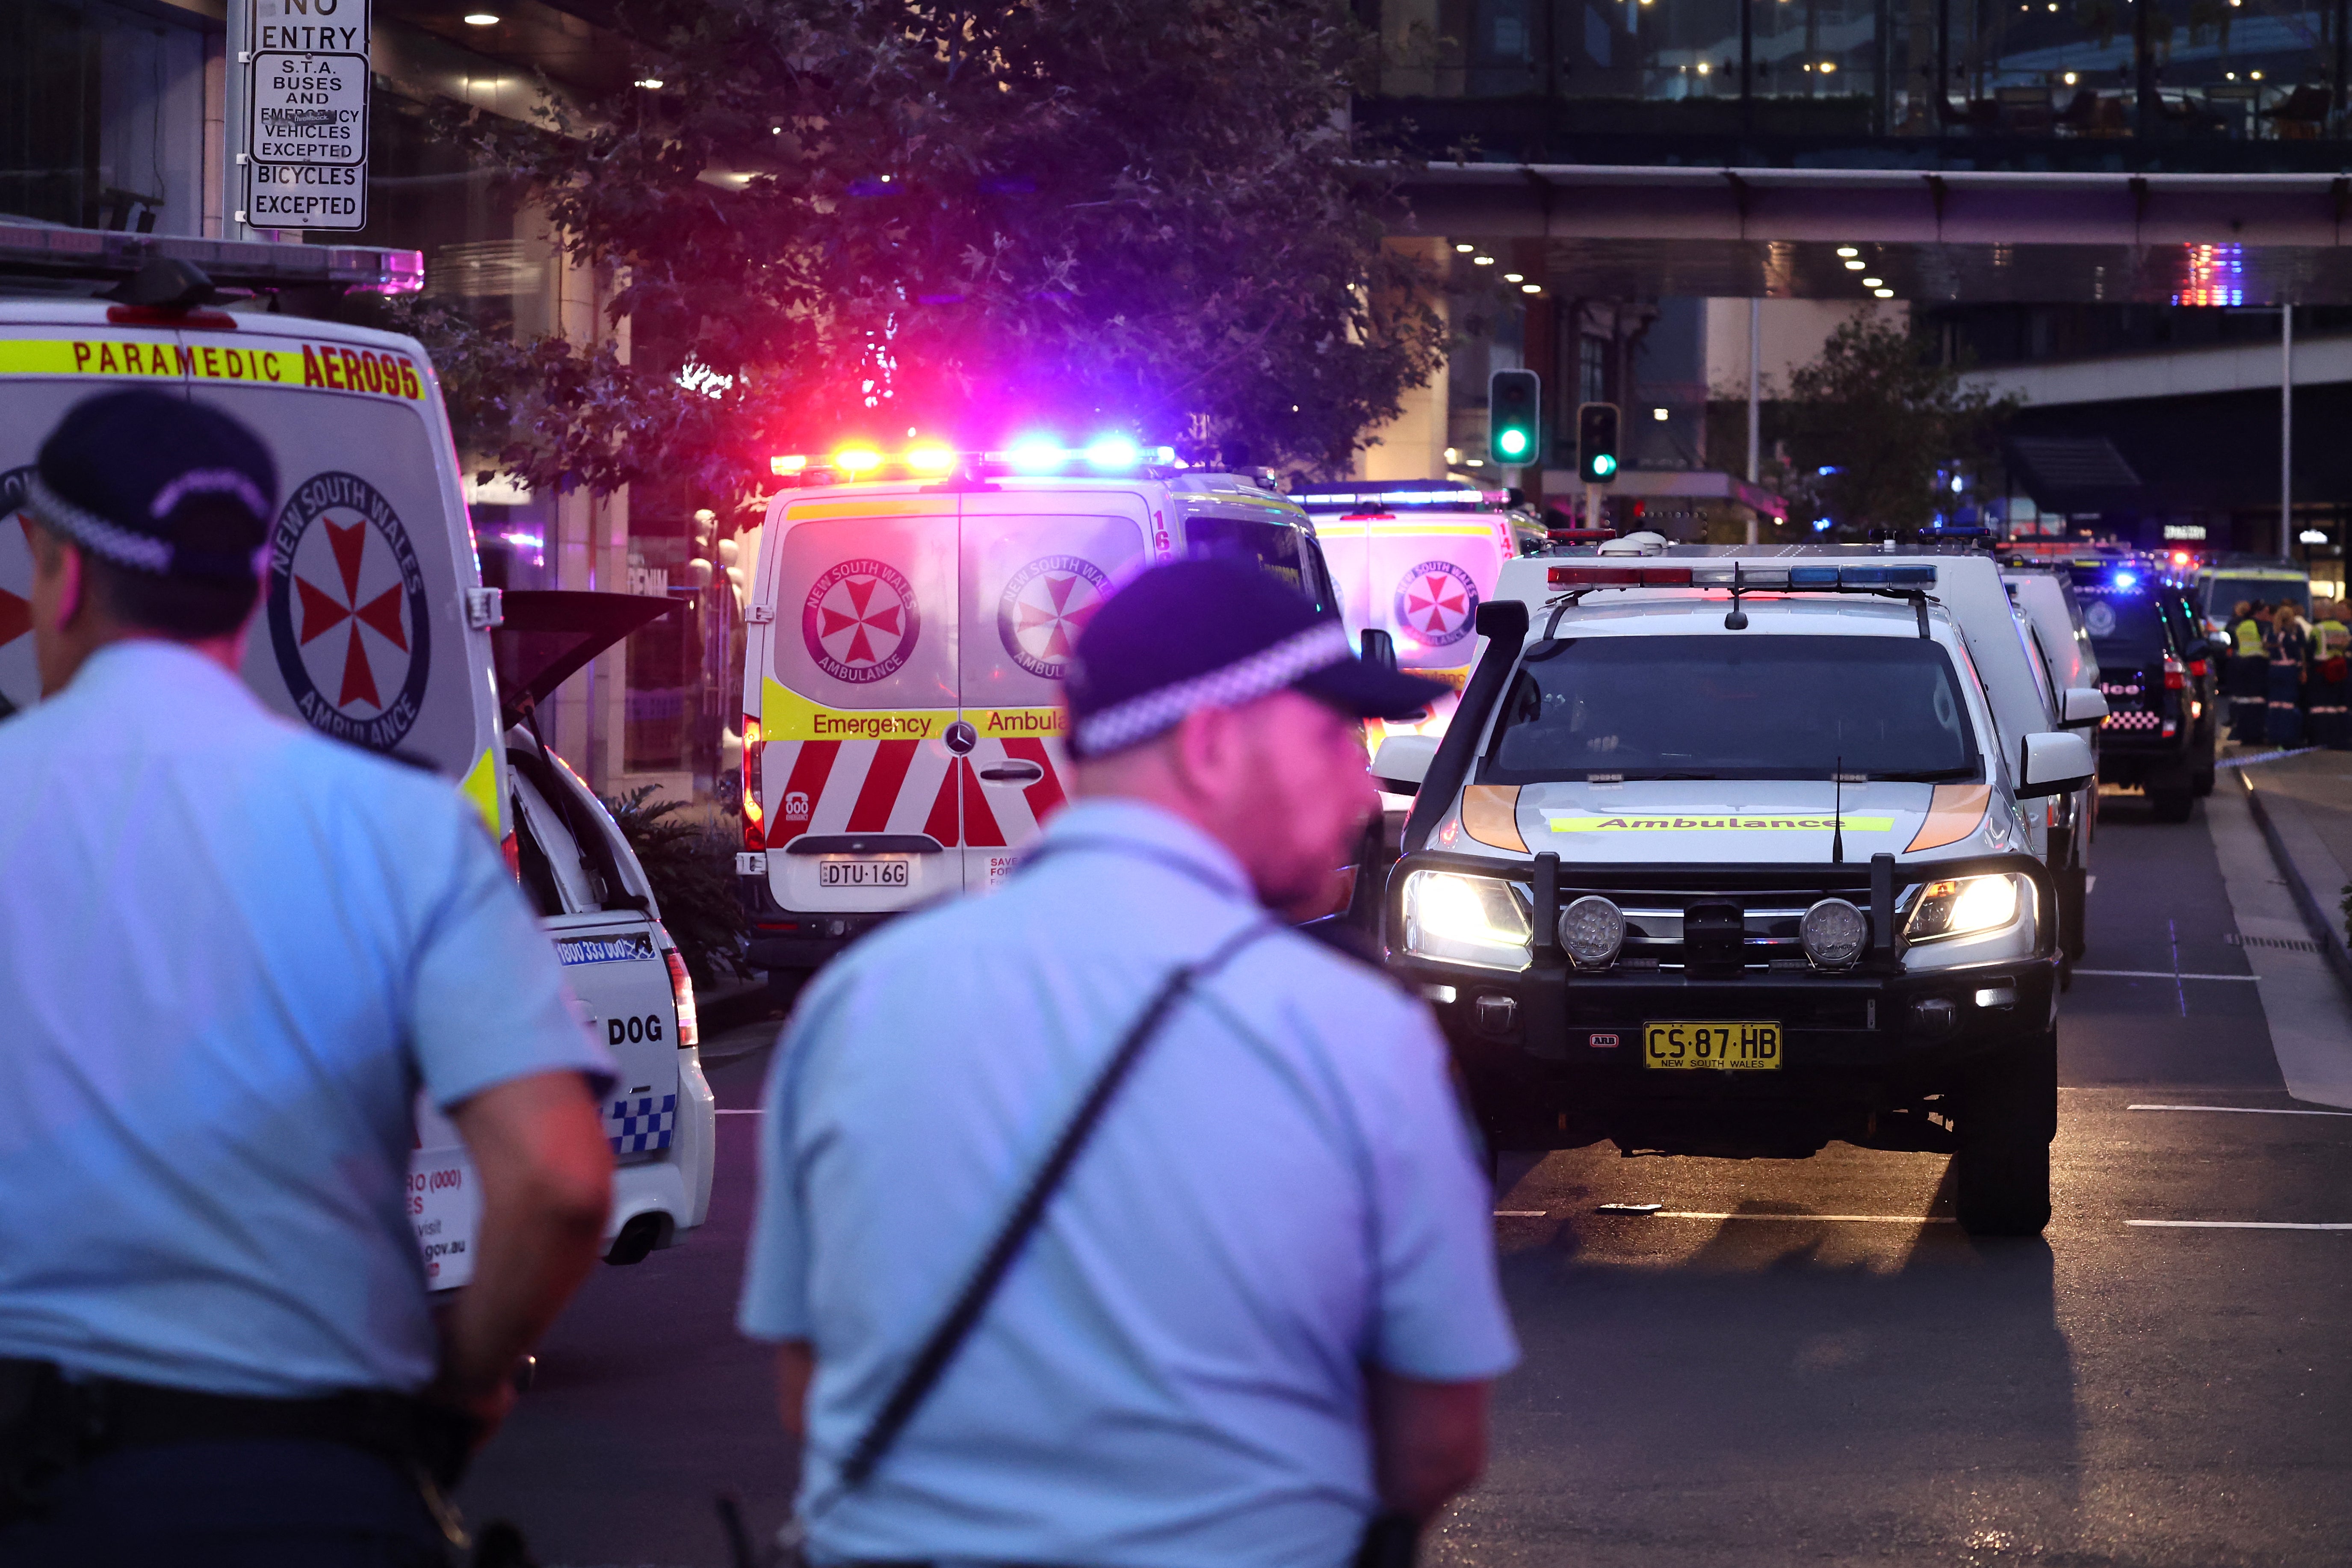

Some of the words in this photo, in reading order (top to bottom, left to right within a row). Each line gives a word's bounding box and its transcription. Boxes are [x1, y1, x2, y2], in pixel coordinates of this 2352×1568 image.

[285, 0, 337, 15] NO
[263, 26, 357, 49] ENTRY
[282, 60, 336, 74] S.T.A.
[274, 77, 342, 91] BUSES
[286, 92, 329, 104] AND
[265, 124, 351, 139] VEHICLES
[262, 142, 352, 157] EXCEPTED
[258, 166, 355, 185] BICYCLES
[257, 195, 356, 214] EXCEPTED
[72, 342, 281, 382] PARAMEDIC
[271, 503, 304, 577] NEW
[301, 476, 366, 515] SOUTH
[371, 494, 421, 595] WALES
[807, 576, 831, 608] NEW
[832, 561, 879, 580] SOUTH
[881, 567, 917, 610] WALES
[1003, 570, 1029, 602] NEW
[1030, 557, 1080, 575] SOUTH
[1082, 564, 1109, 592] WAL
[1415, 561, 1450, 575] SOUTH
[1451, 566, 1477, 598] WALES
[818, 653, 903, 681] AMBULANCE
[1013, 651, 1063, 677] AMBUL
[813, 714, 931, 738] Emergency
[987, 711, 1068, 731] Ambula
[786, 801, 808, 814] 000
[1596, 818, 1846, 829] Ambulance
[990, 858, 1018, 866] SAVE
[557, 942, 585, 963] 1800
[608, 1014, 662, 1045] DOG
[1690, 1060, 1724, 1068] SOUTH
[429, 1169, 462, 1193] (000)
